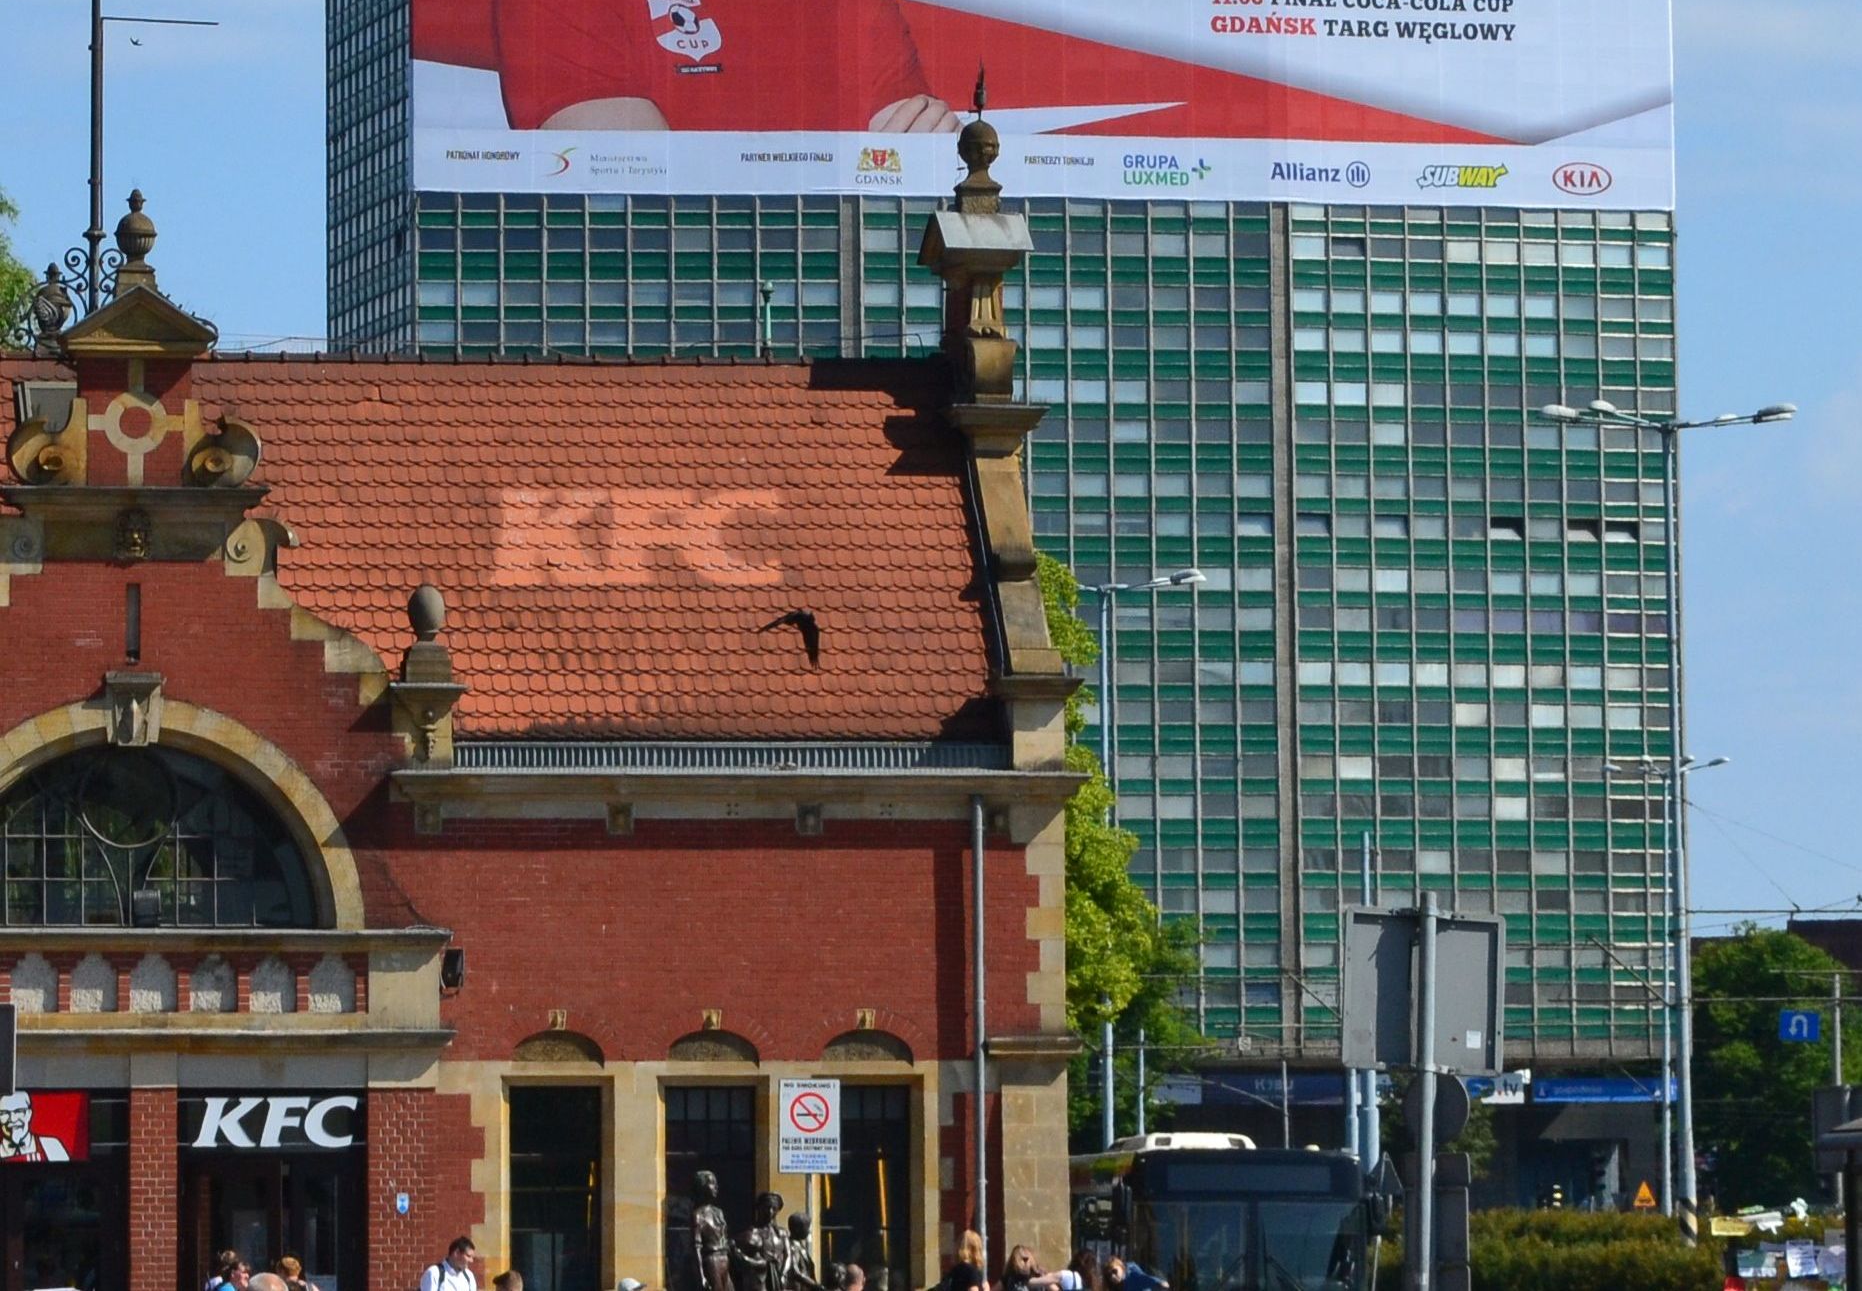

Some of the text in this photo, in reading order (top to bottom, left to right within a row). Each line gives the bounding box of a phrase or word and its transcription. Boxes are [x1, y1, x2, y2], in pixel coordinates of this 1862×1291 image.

[1210, 11, 1516, 44] GDAŃSK TARG WĘGLOWY
[676, 39, 709, 49] CUP
[740, 153, 771, 162] PARTNER
[772, 153, 808, 162] WIELKIEGO
[1122, 154, 1180, 170] GRUPA
[1123, 171, 1190, 186] LUXMED
[1270, 162, 1341, 183] Allianz
[1417, 163, 1508, 190] SUBWAY
[1562, 170, 1602, 188] KIA
[491, 486, 784, 586] KFC
[192, 1096, 358, 1148] KFC
